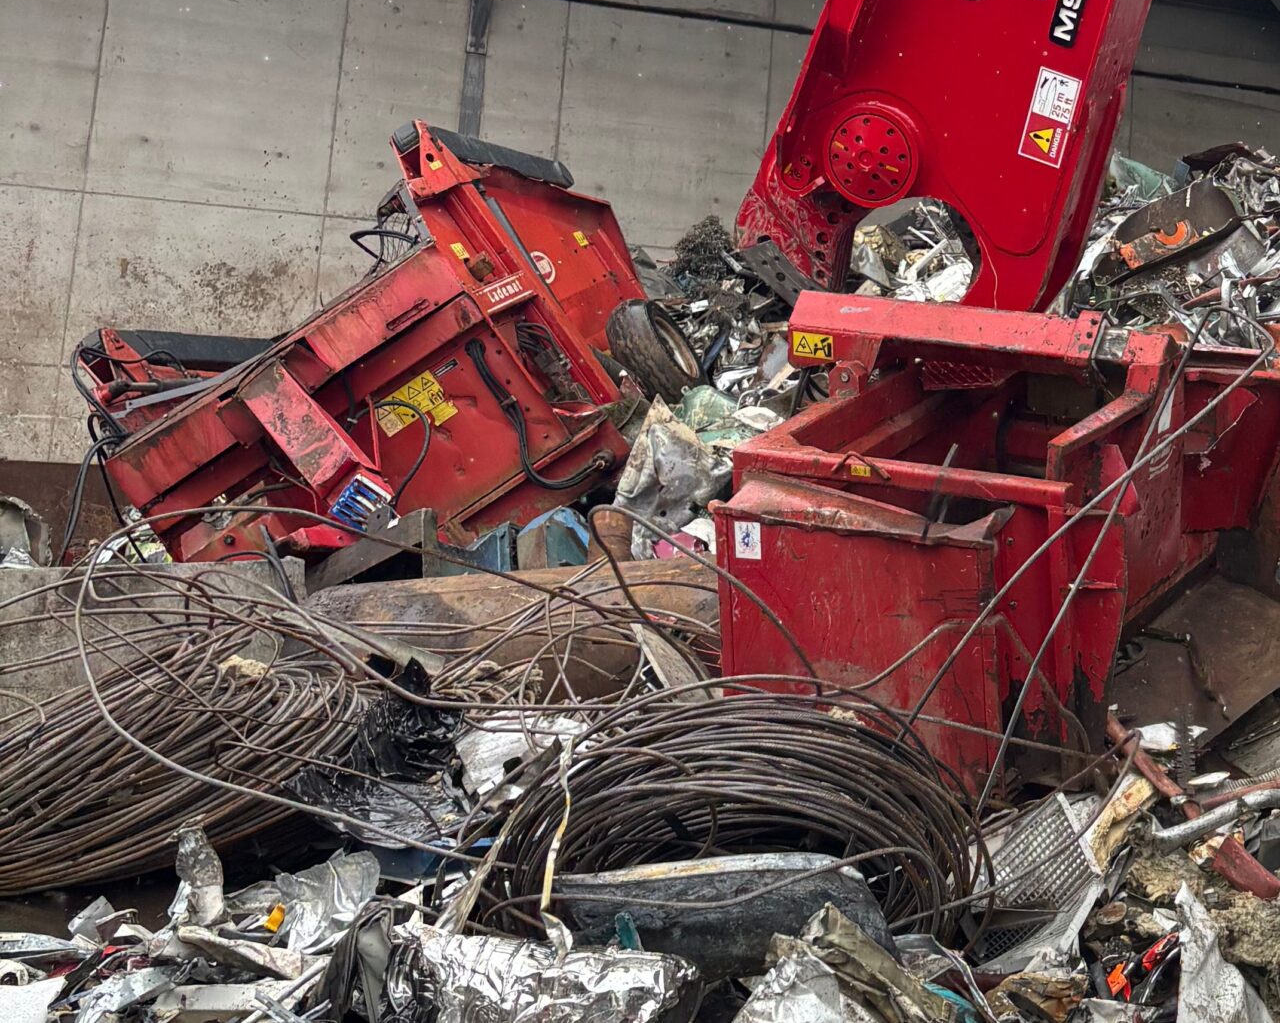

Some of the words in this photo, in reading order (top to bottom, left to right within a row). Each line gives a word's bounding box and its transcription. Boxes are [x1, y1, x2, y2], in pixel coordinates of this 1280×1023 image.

[1051, 103, 1062, 118] 25
[1057, 92, 1065, 103] m
[1060, 107, 1071, 120] 75
[1049, 127, 1063, 159] DANGER
